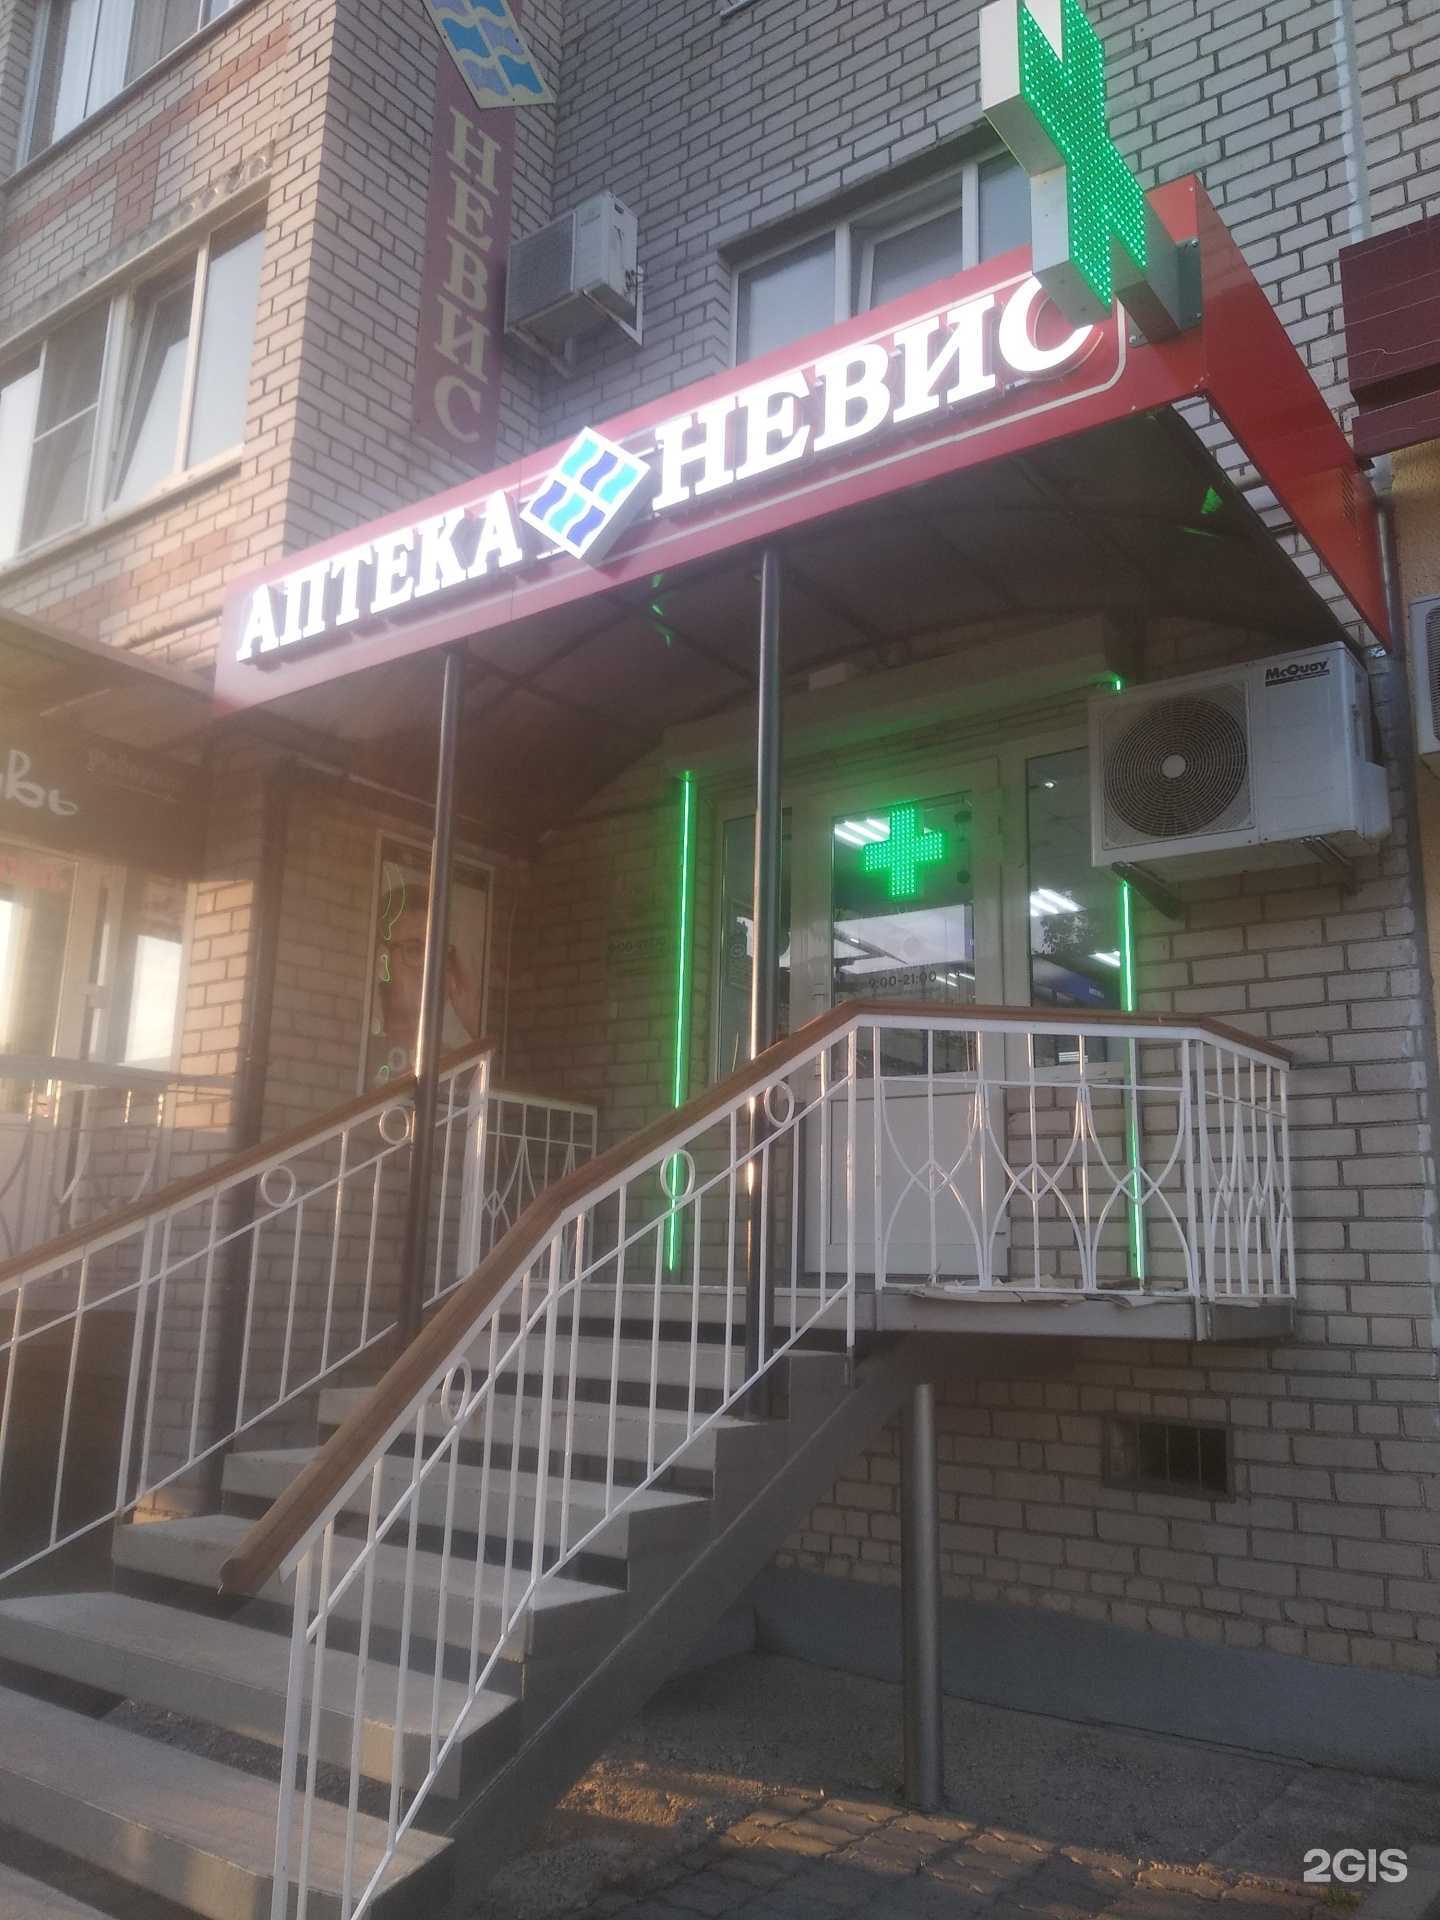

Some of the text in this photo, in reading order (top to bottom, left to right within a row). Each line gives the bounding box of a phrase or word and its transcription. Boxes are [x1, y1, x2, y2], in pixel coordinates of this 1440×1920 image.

[433, 105, 501, 443] НЕВИС
[236, 274, 1095, 662] АПТЕКА НЕВИС
